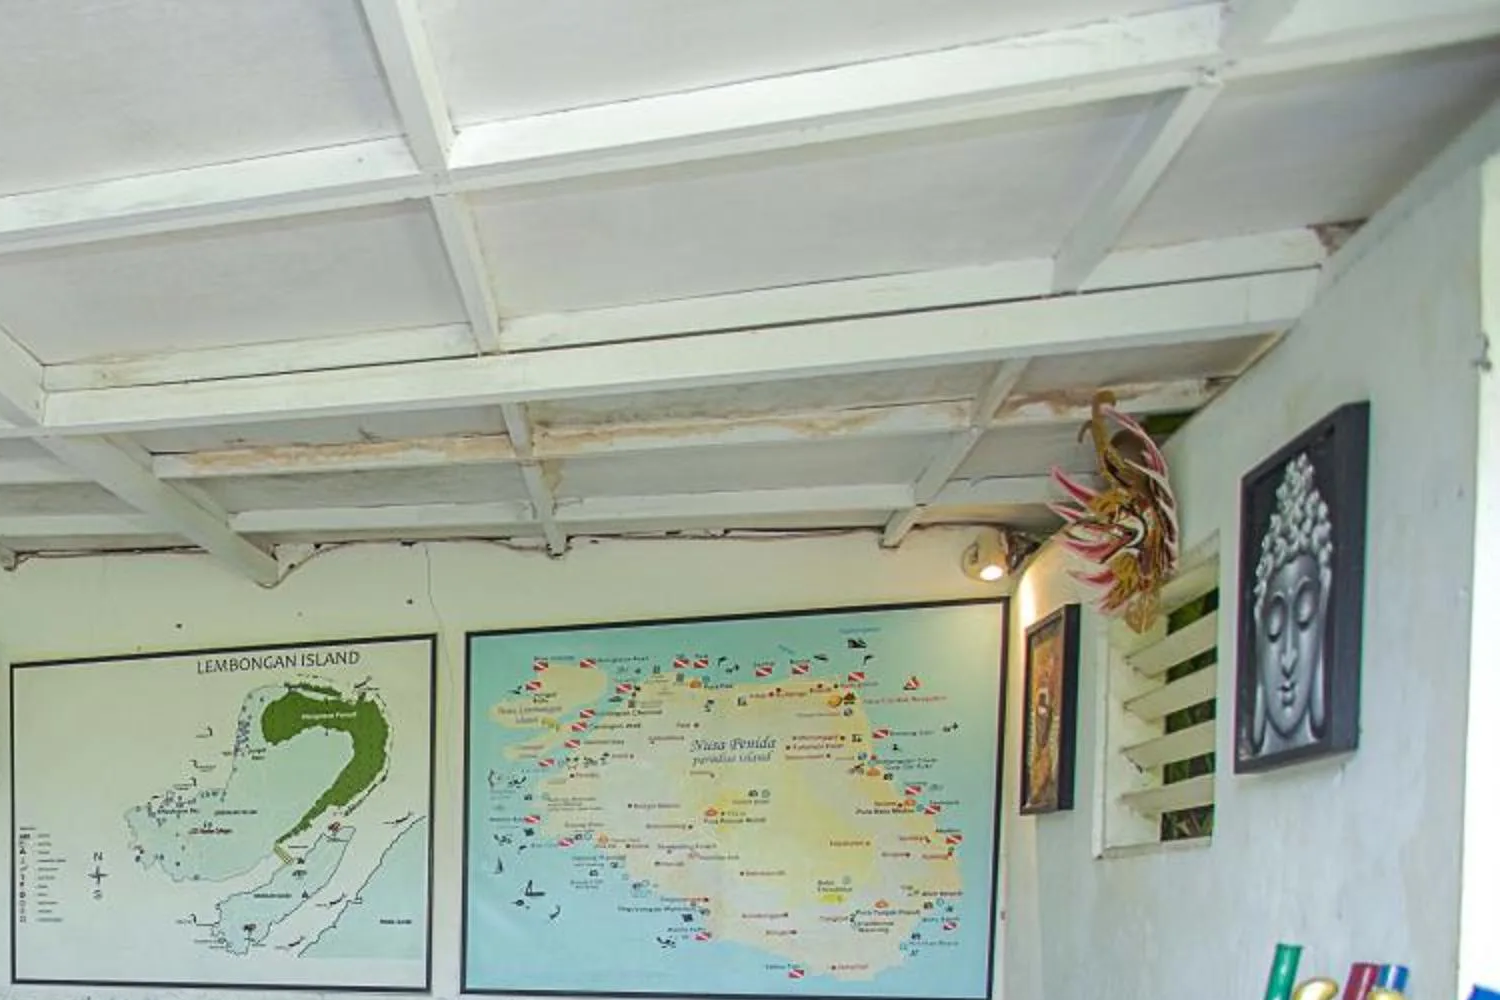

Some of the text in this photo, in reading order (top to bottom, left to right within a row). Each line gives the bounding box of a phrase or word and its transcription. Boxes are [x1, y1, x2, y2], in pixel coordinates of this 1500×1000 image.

[197, 651, 361, 675] LEMBONGAN ISLAND
[690, 736, 777, 752] Nusa Penida
